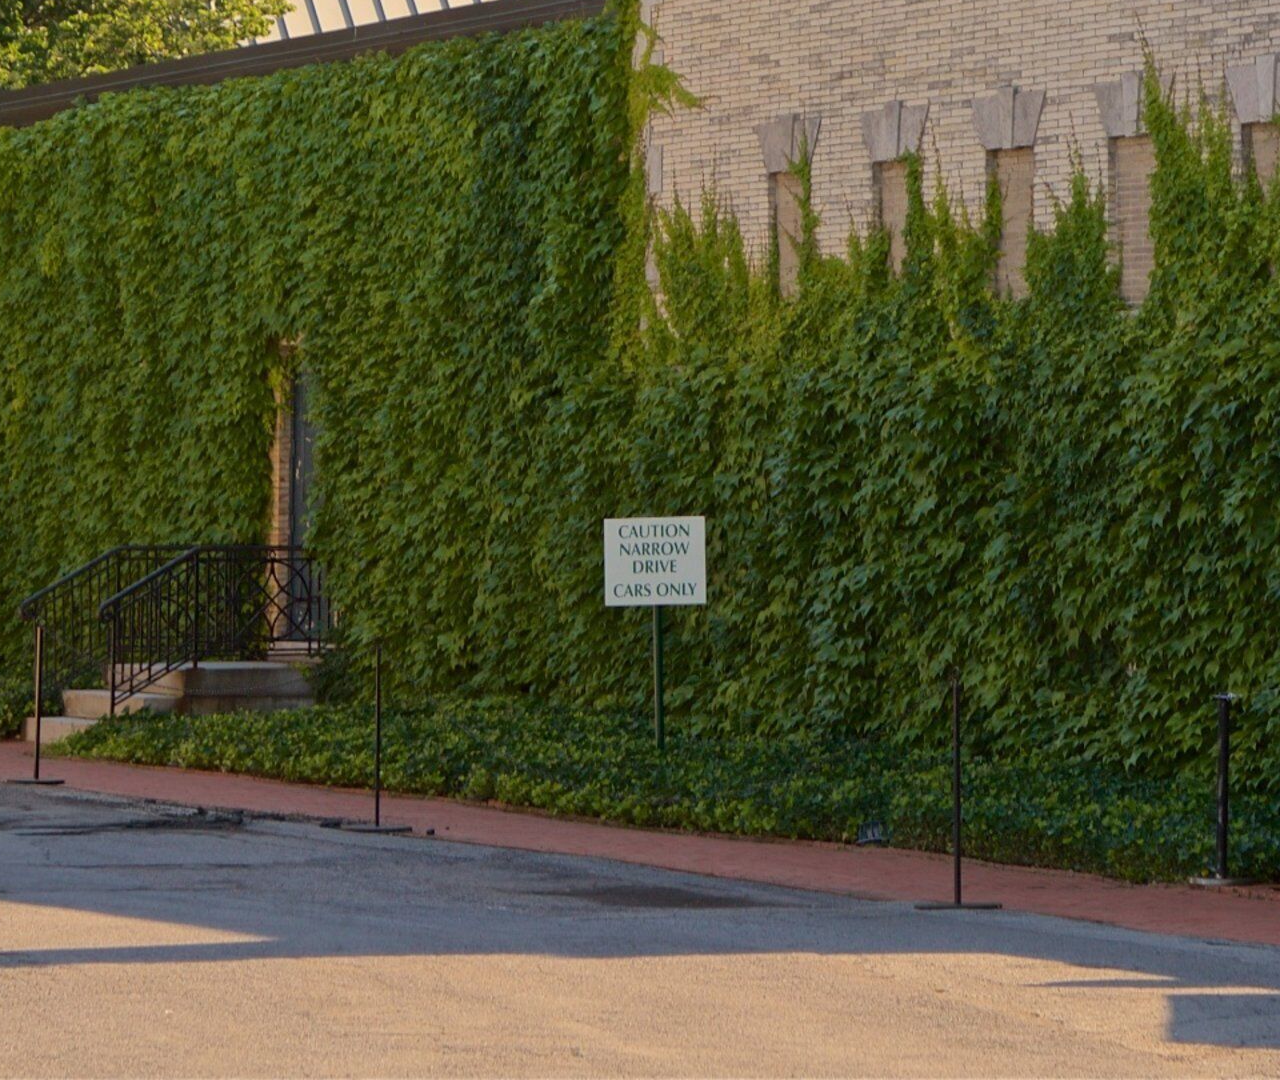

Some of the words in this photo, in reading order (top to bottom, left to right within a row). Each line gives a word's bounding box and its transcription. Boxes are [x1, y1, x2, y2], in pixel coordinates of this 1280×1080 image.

[618, 523, 690, 539] CAUTION
[619, 541, 690, 557] NARROW
[633, 559, 677, 574] DRIVE
[613, 583, 651, 598] CARS
[656, 582, 697, 597] ONLY
